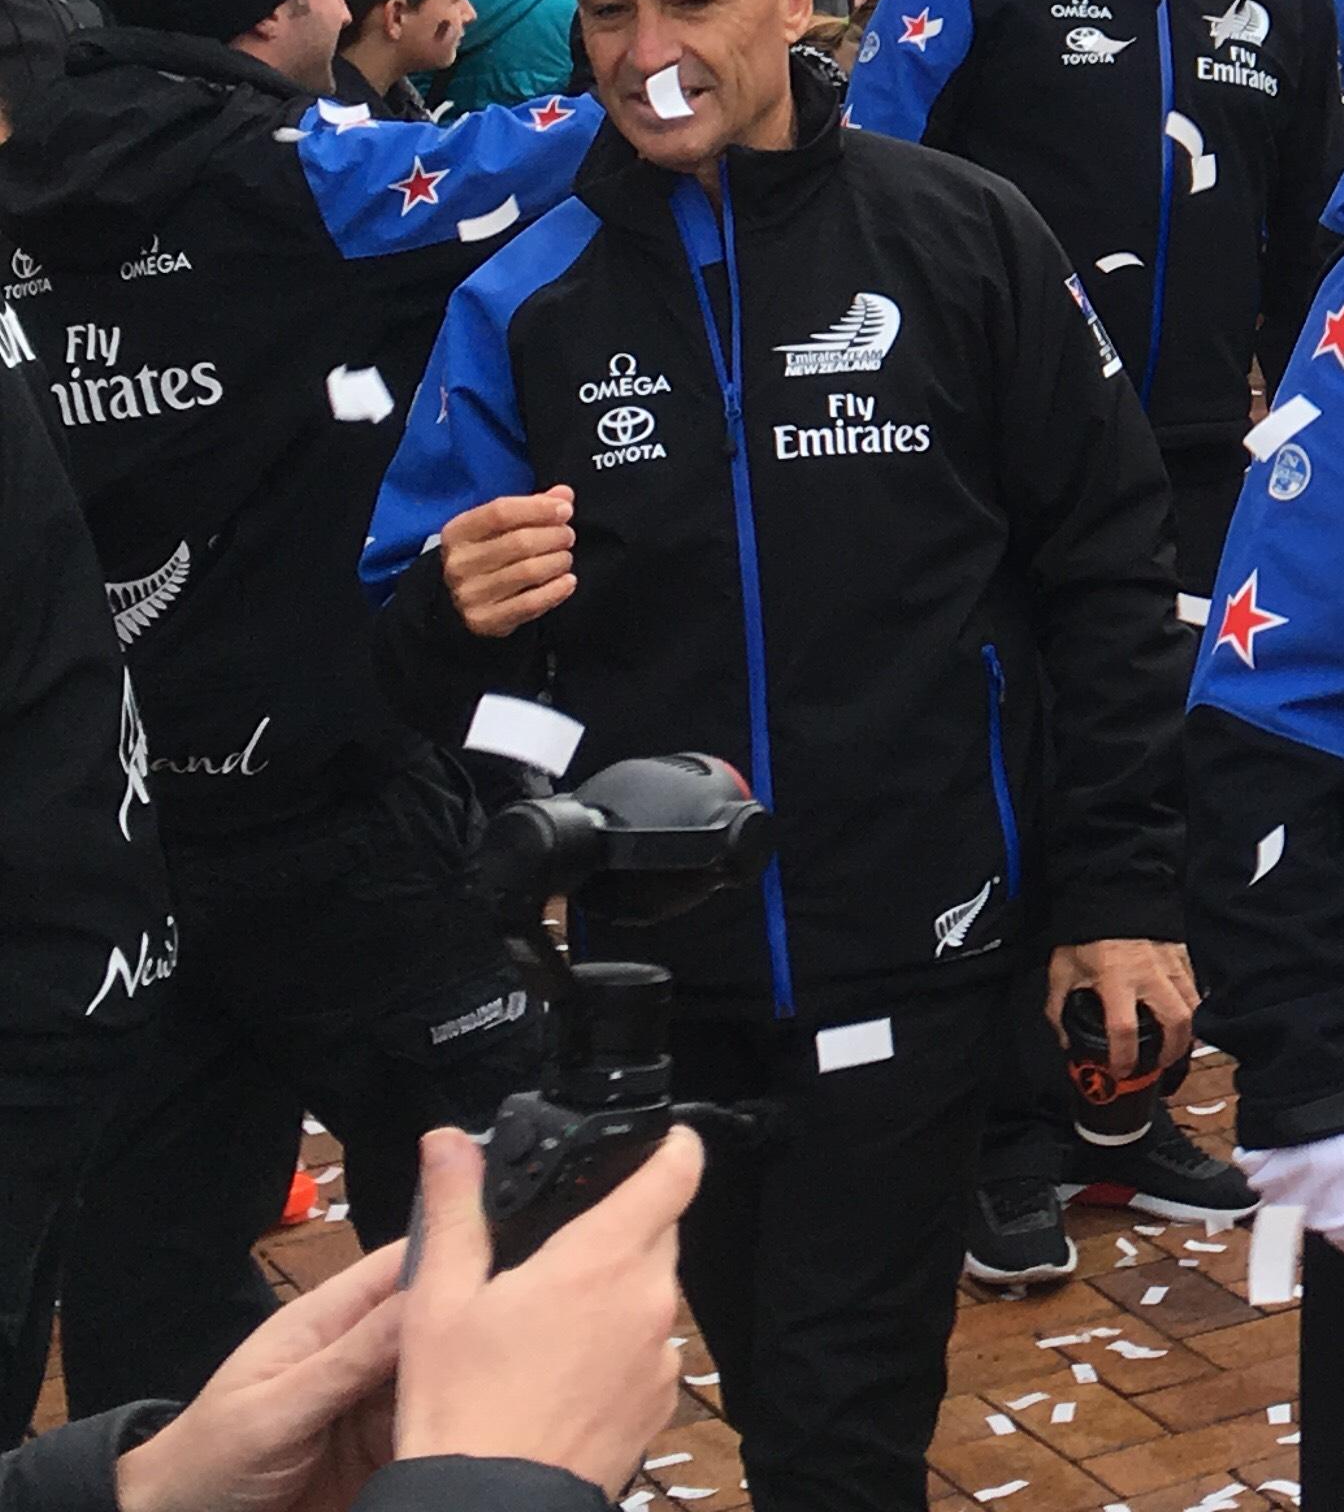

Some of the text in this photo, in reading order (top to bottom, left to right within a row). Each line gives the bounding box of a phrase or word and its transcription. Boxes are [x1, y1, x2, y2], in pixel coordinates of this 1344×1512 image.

[1050, 3, 1112, 20] OMEGA
[1061, 53, 1115, 66] TOYOTA
[1230, 45, 1256, 68] Fly
[1197, 56, 1279, 97] Emirates
[120, 251, 193, 280] OMEGA
[4, 278, 53, 300] TOYOTA
[66, 323, 121, 367] Fly
[579, 374, 672, 404] OMEGA
[828, 393, 875, 421] Fly
[773, 419, 930, 460] Emirates
[592, 443, 667, 470] TOYOTA
